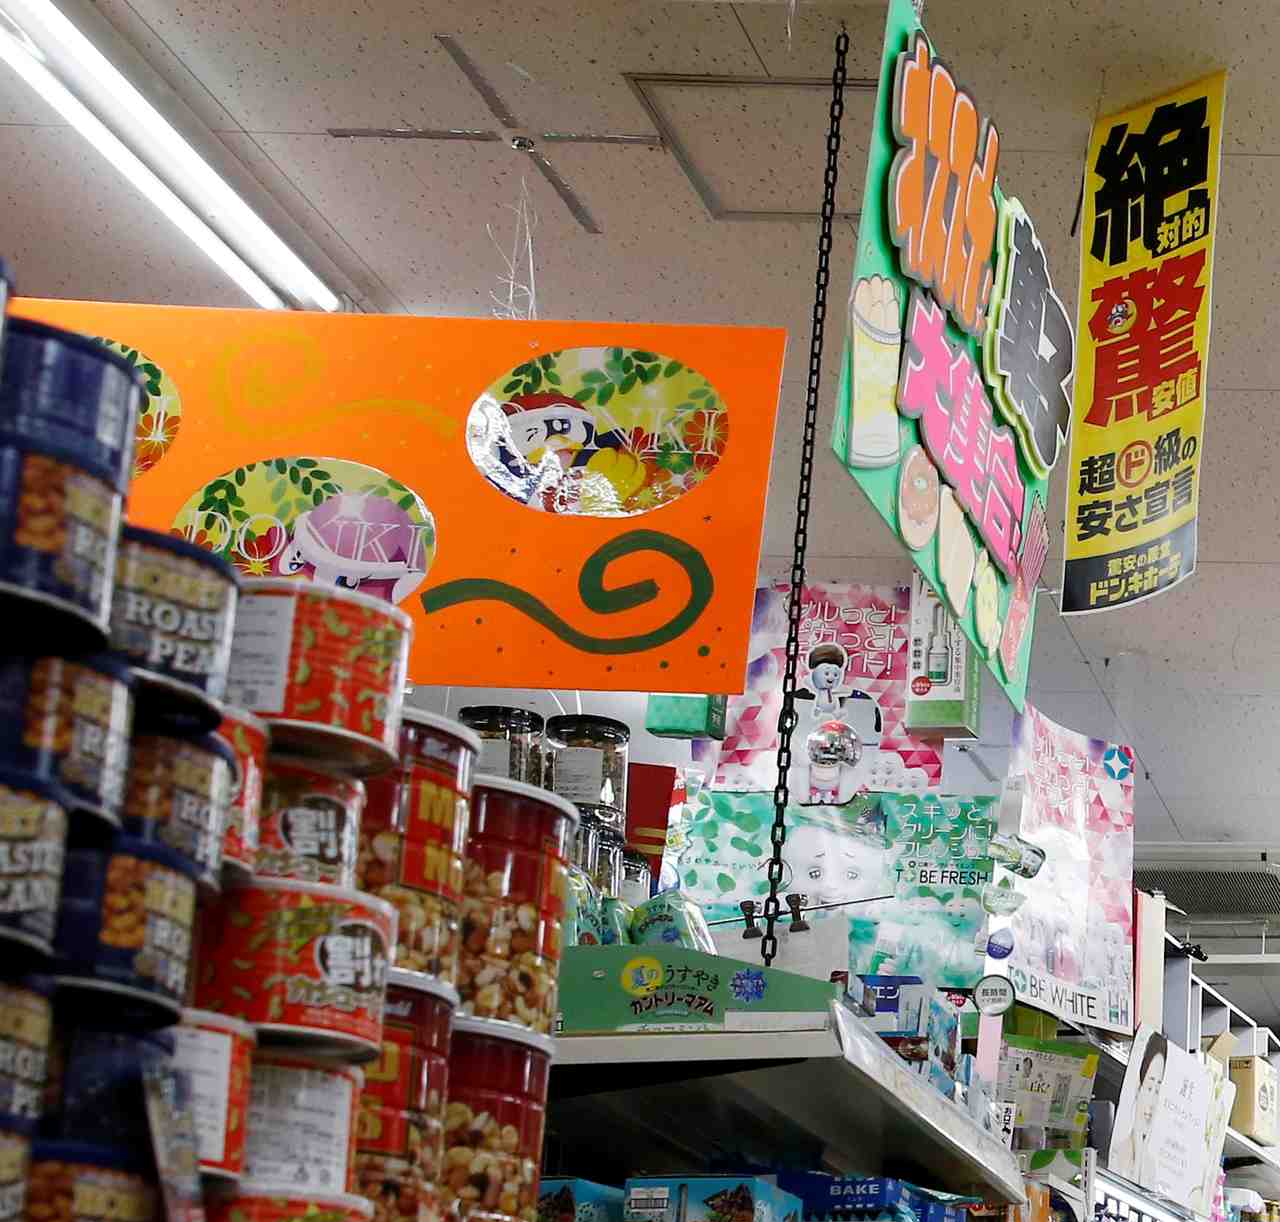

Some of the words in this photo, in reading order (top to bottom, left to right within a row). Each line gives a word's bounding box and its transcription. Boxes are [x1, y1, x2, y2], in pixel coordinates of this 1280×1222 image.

[1092, 95, 1210, 268] 絶
[1153, 206, 1208, 257] 対的
[1079, 432, 1198, 497] 超ド級の
[1075, 468, 1196, 543] 安さ宣言
[919, 869, 940, 886] BE
[940, 869, 988, 887] FRESH
[980, 986, 1008, 998] 長時間
[1050, 982, 1098, 1020] WHITE
